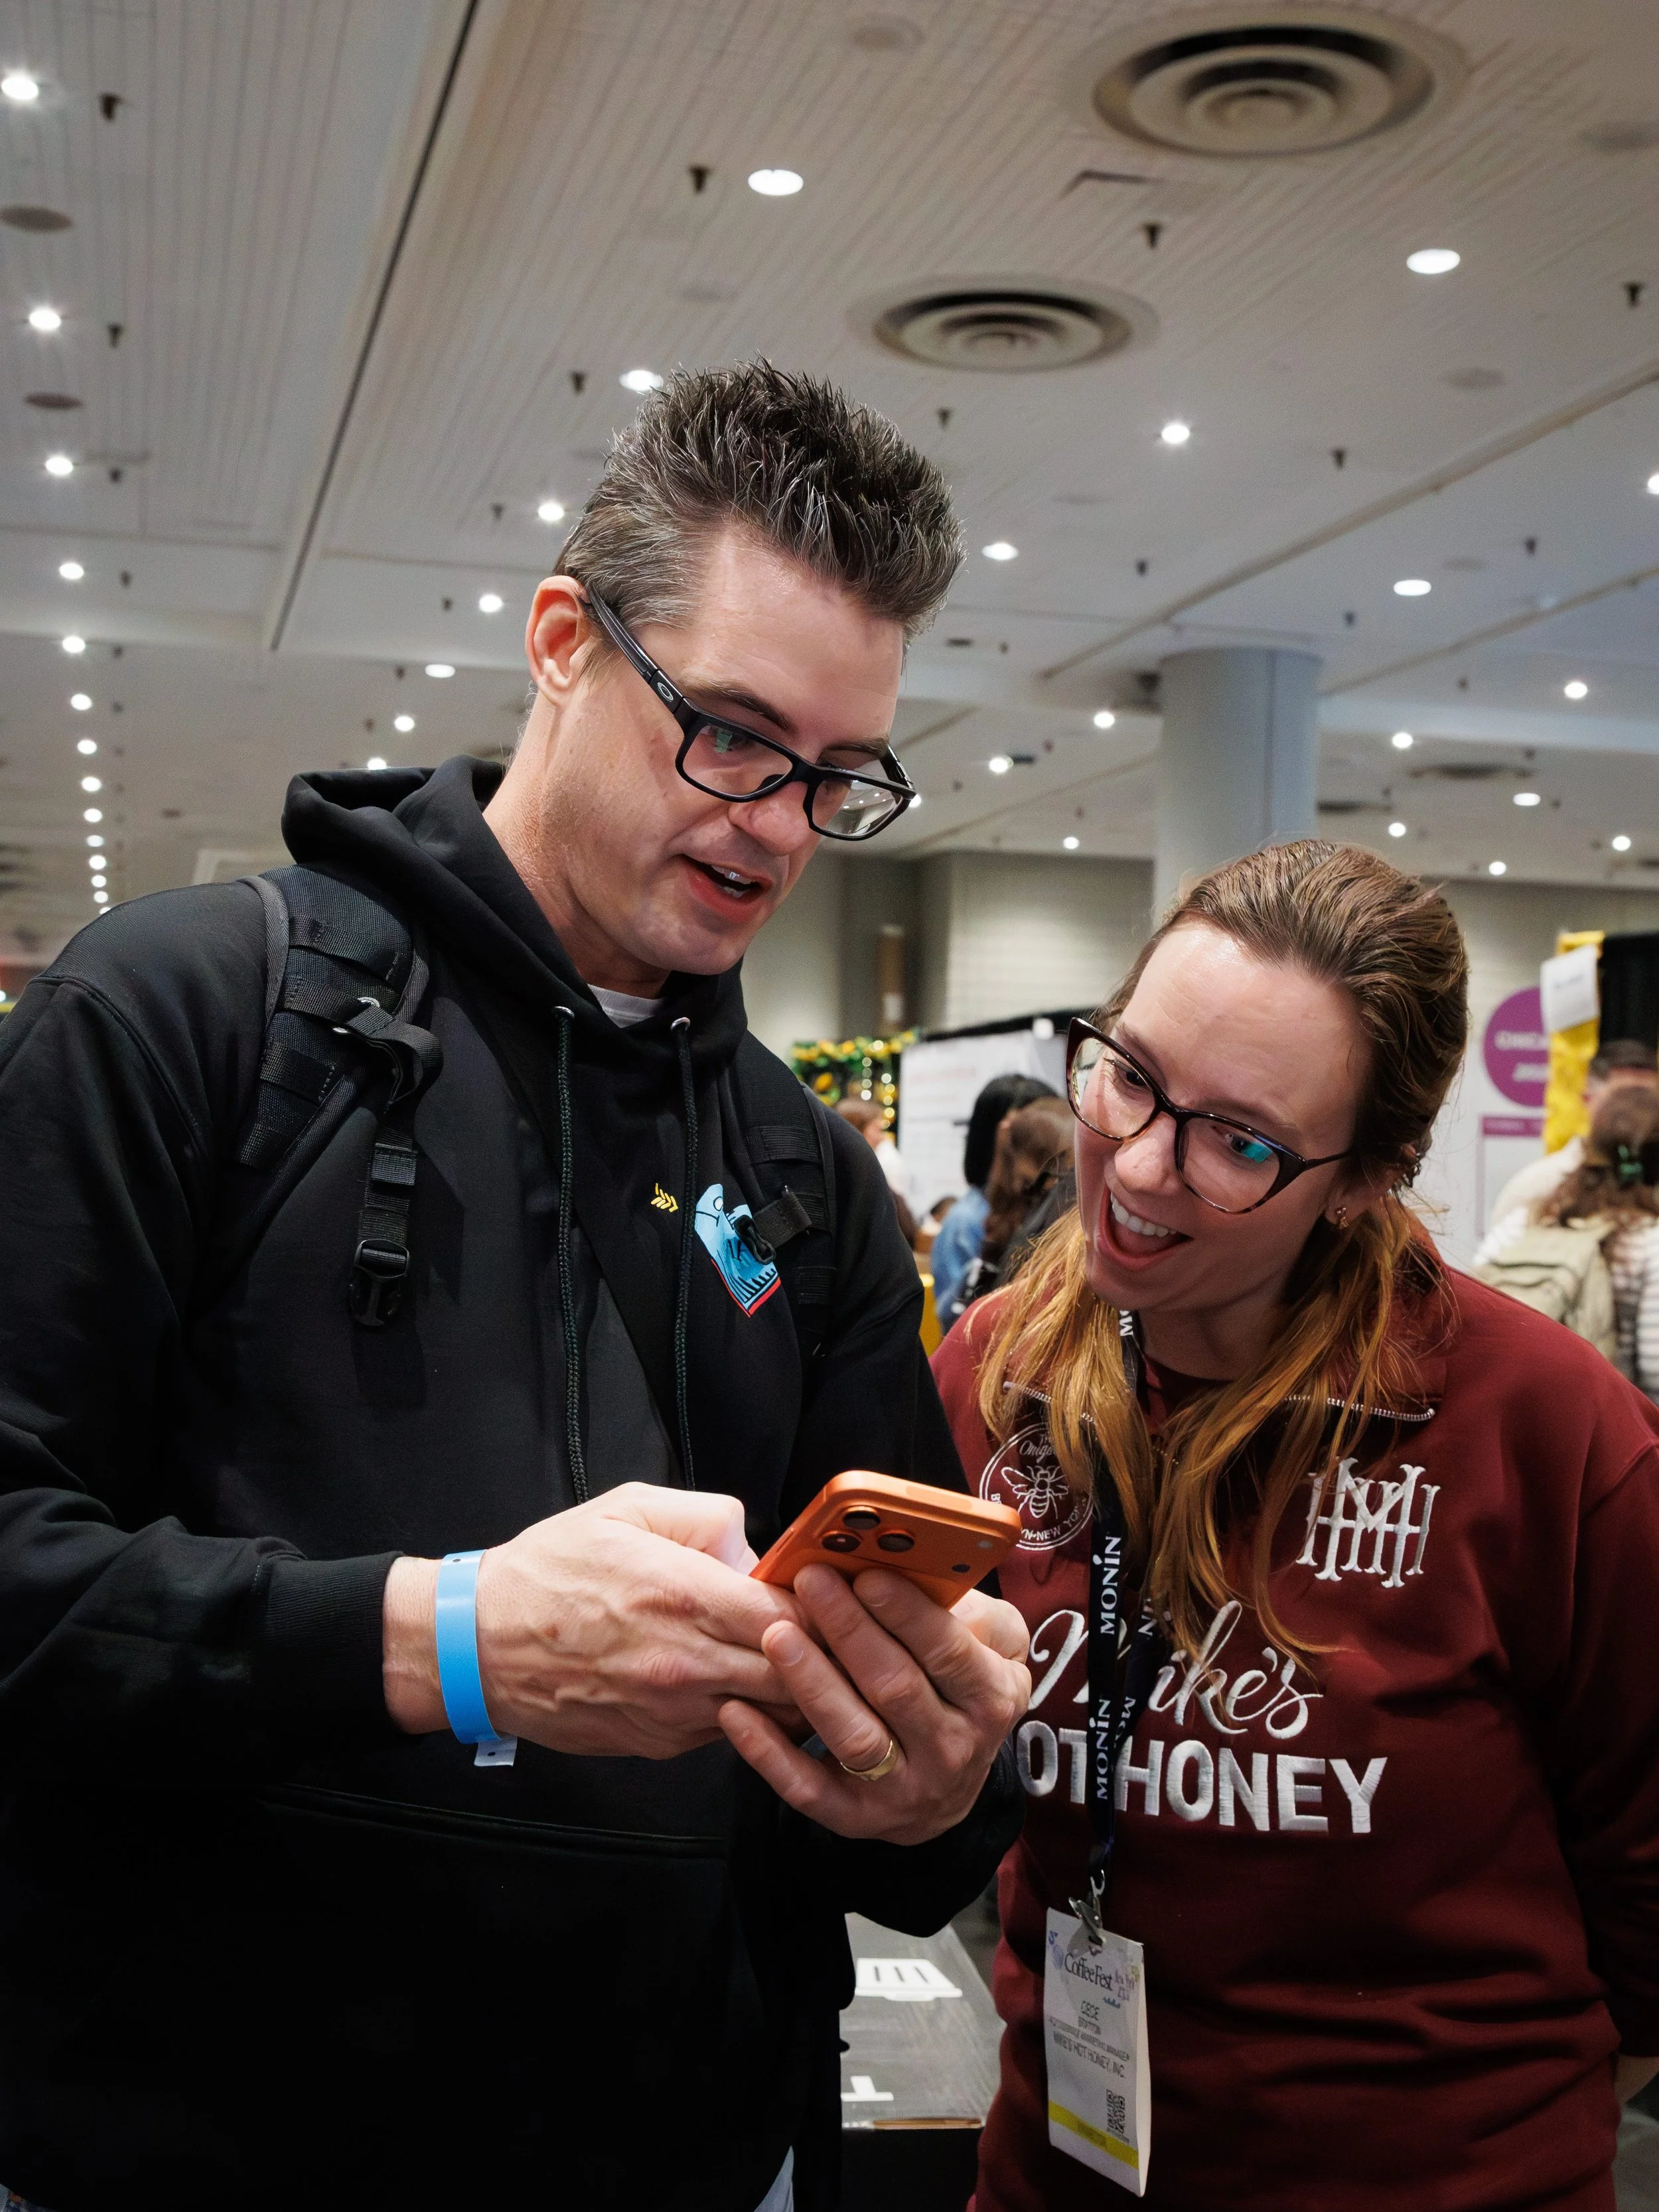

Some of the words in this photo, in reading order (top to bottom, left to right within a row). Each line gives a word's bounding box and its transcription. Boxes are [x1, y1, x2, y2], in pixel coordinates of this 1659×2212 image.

[1036, 1525, 1061, 1541] NEW
[1016, 1720, 1088, 1805] OT
[1114, 1735, 1388, 1834] HONEY
